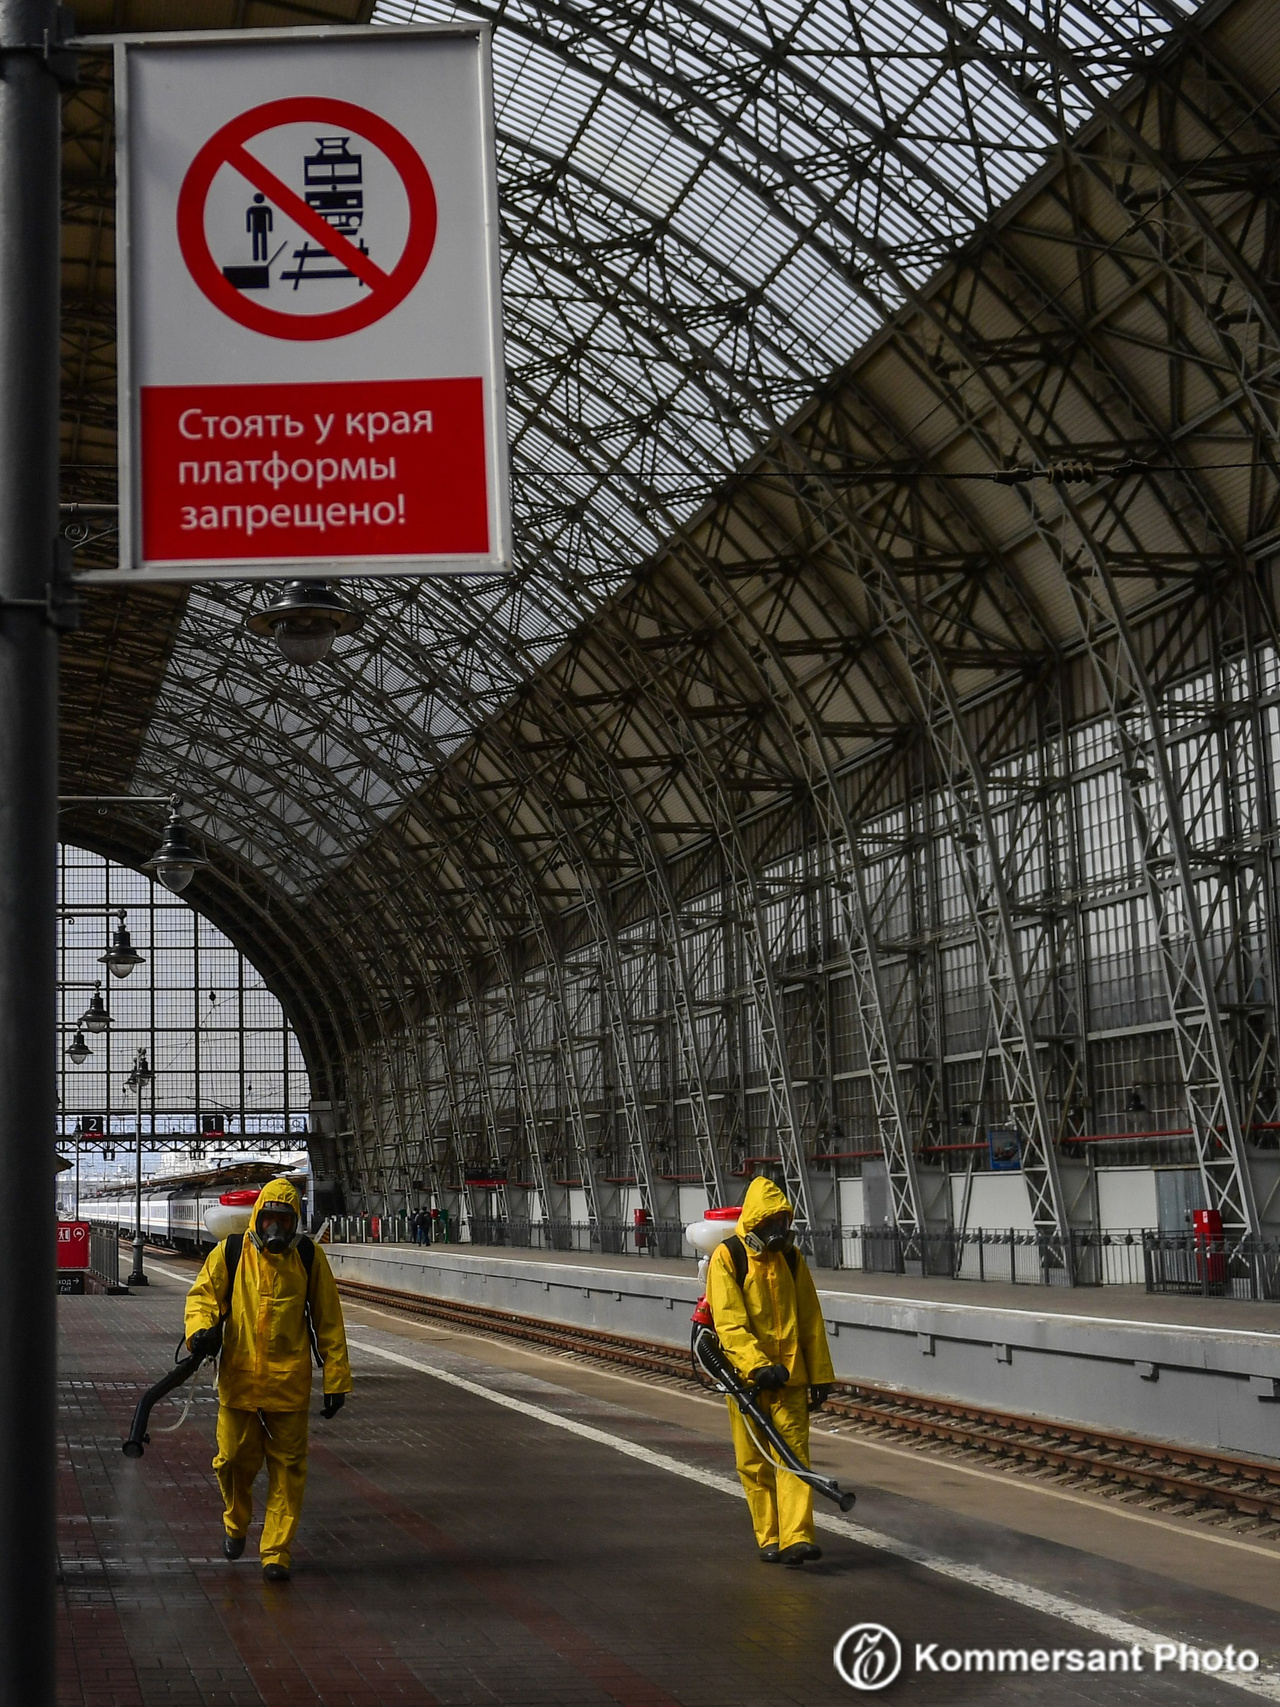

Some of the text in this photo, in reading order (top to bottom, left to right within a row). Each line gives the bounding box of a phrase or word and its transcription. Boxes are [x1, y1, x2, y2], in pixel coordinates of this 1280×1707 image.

[178, 408, 433, 445] Стоять у края
[179, 450, 396, 490] платформы
[180, 493, 406, 536] запрещено!
[88, 1118, 98, 1131] 2
[210, 1118, 216, 1130] 1
